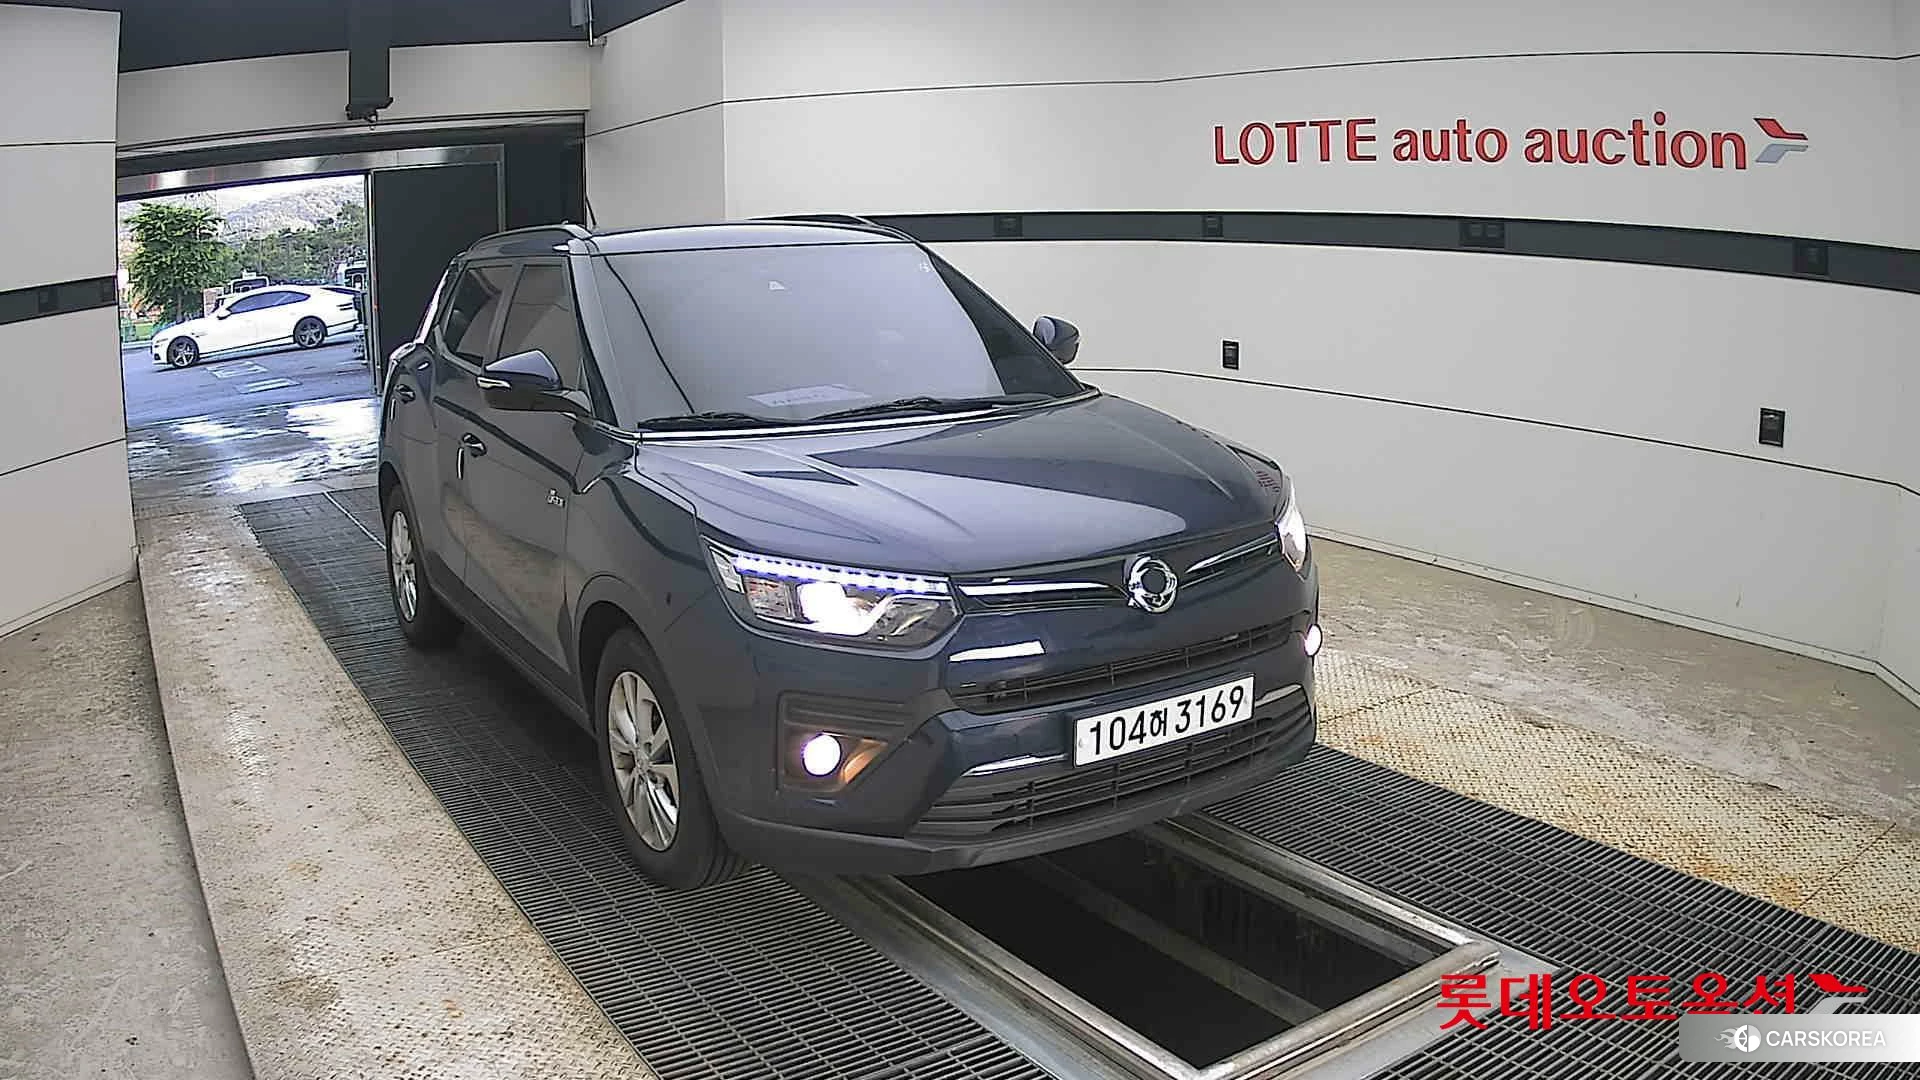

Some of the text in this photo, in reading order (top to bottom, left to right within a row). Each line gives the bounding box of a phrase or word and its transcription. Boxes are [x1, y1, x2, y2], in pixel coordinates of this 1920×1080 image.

[1214, 112, 1748, 170] LOTTE auto auction
[1175, 685, 1244, 734] 3169
